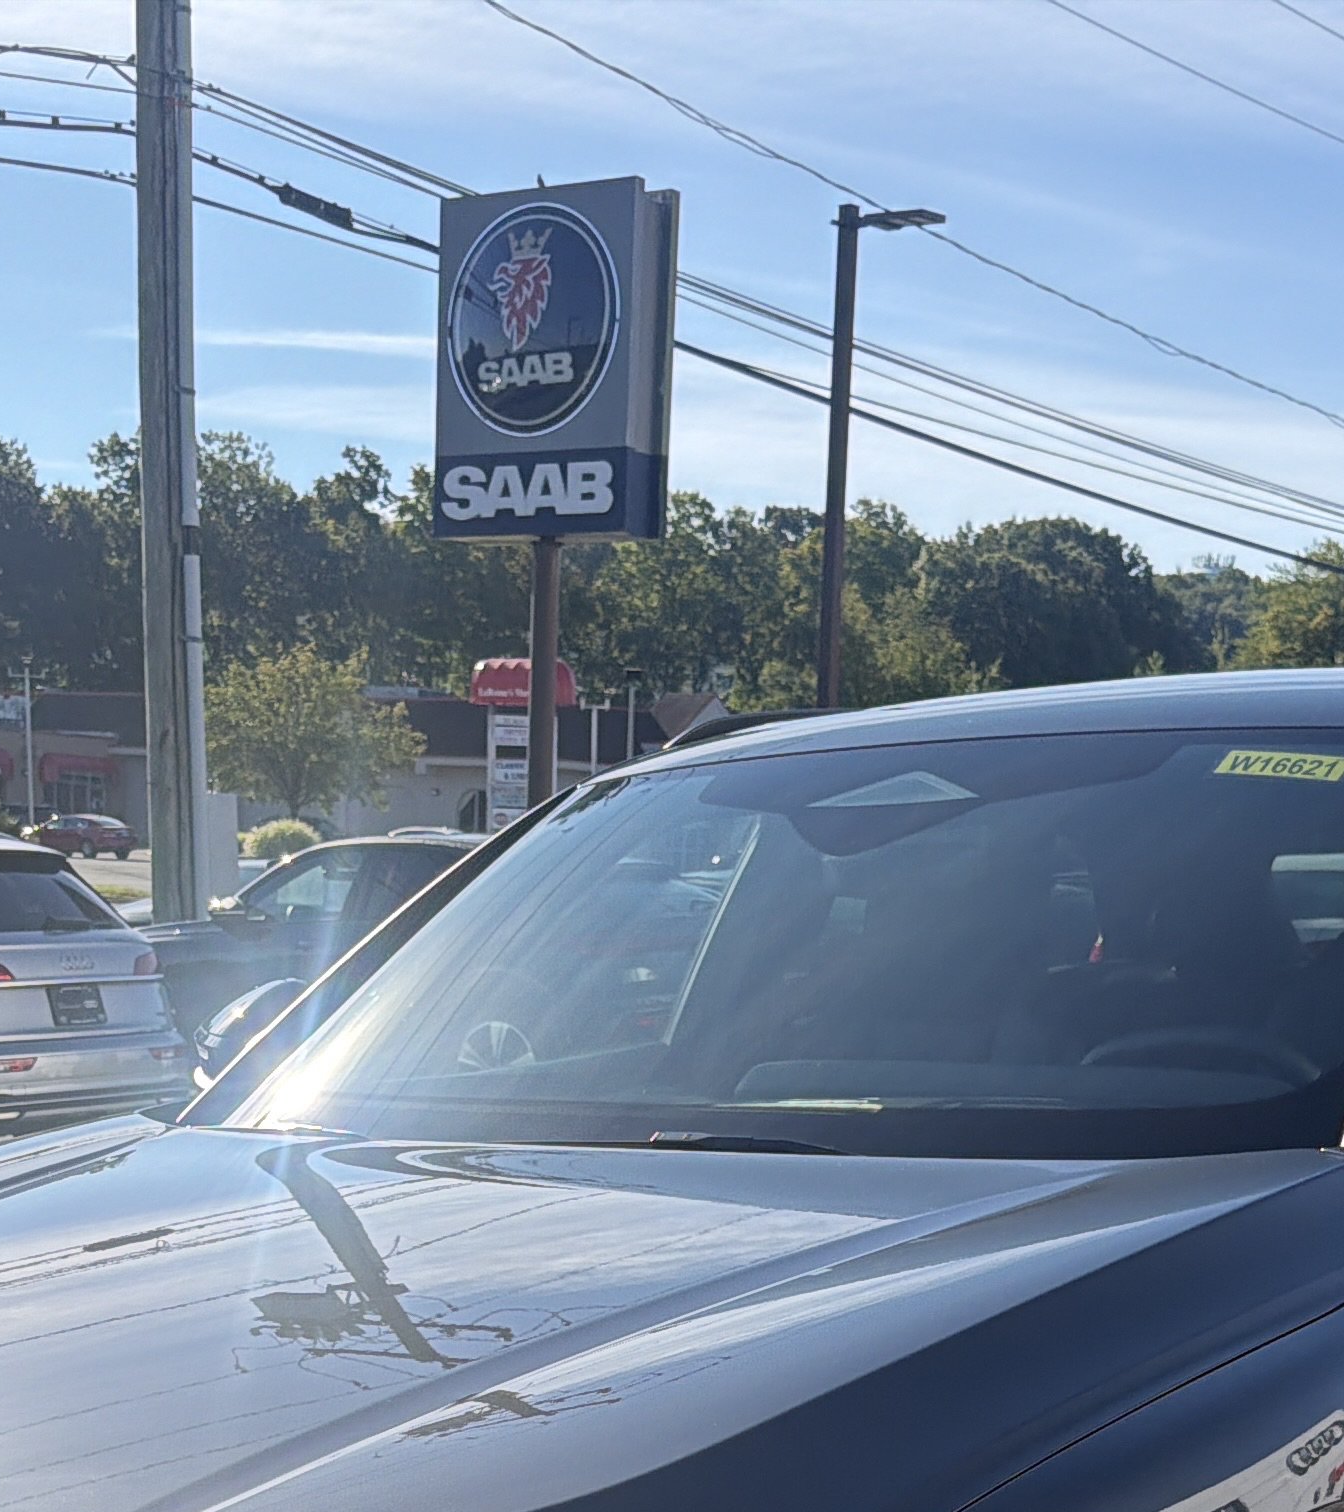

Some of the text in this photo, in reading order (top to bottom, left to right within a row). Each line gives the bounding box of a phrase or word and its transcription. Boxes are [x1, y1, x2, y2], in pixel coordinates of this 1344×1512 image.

[477, 351, 574, 393] SAAB
[440, 460, 614, 521] SAAB
[1228, 754, 1340, 778] W16621
